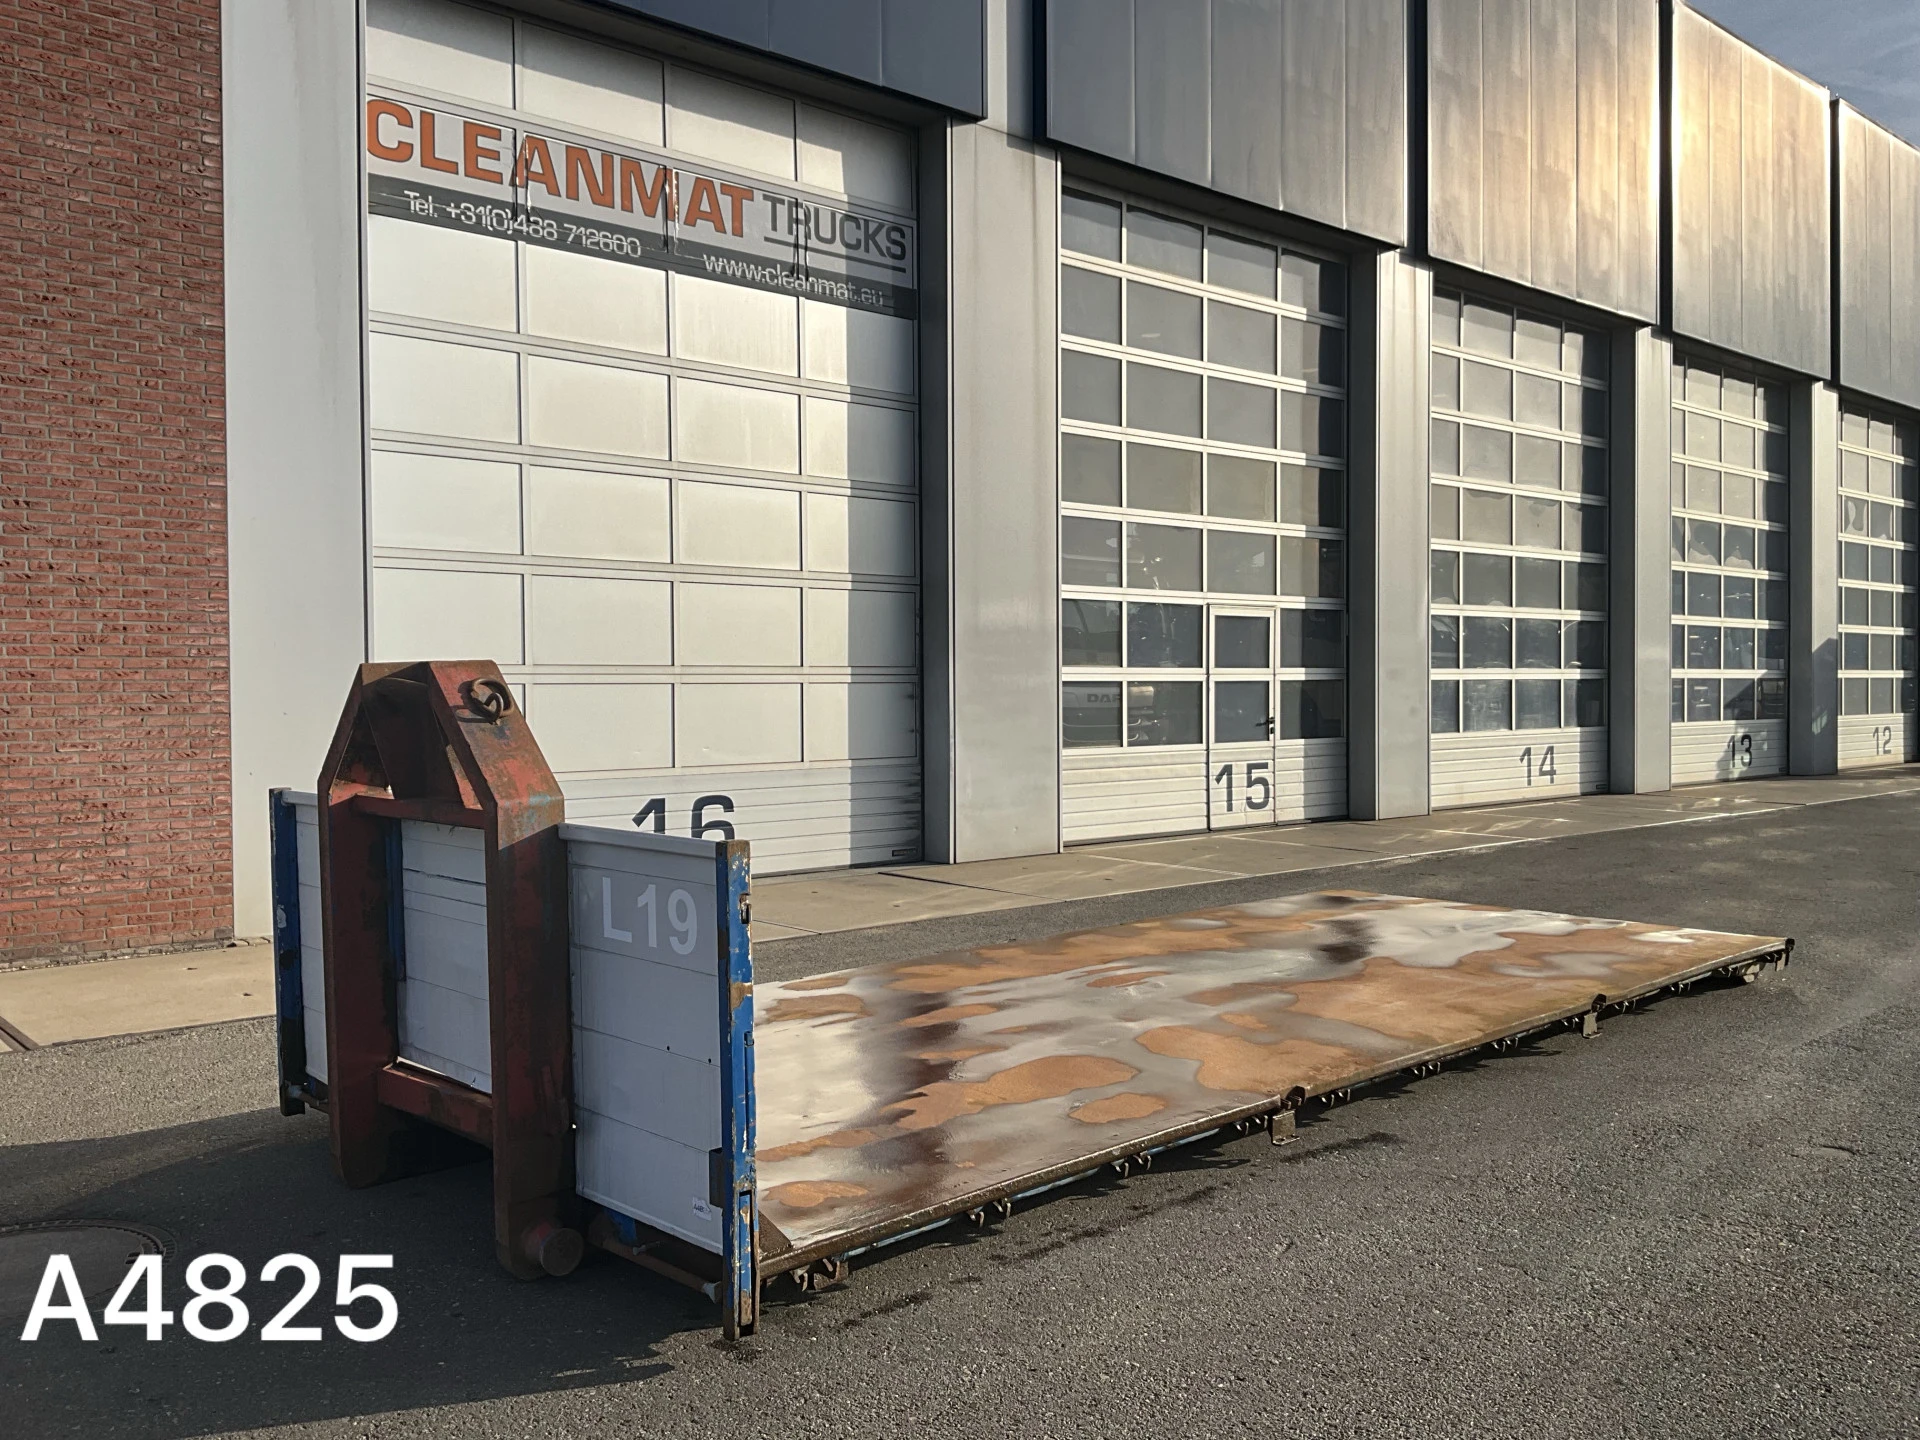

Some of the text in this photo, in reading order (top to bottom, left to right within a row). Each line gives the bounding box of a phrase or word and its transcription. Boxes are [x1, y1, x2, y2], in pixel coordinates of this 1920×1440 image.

[366, 98, 907, 261] CLEANMAT TRUCKS
[404, 190, 438, 218] Tel.
[703, 254, 884, 307] www.cleanmat.eu
[1727, 734, 1752, 768] 13
[1873, 726, 1892, 756] 12
[1214, 762, 1270, 813] 15
[1519, 745, 1557, 787] 14
[602, 876, 698, 955] L19
